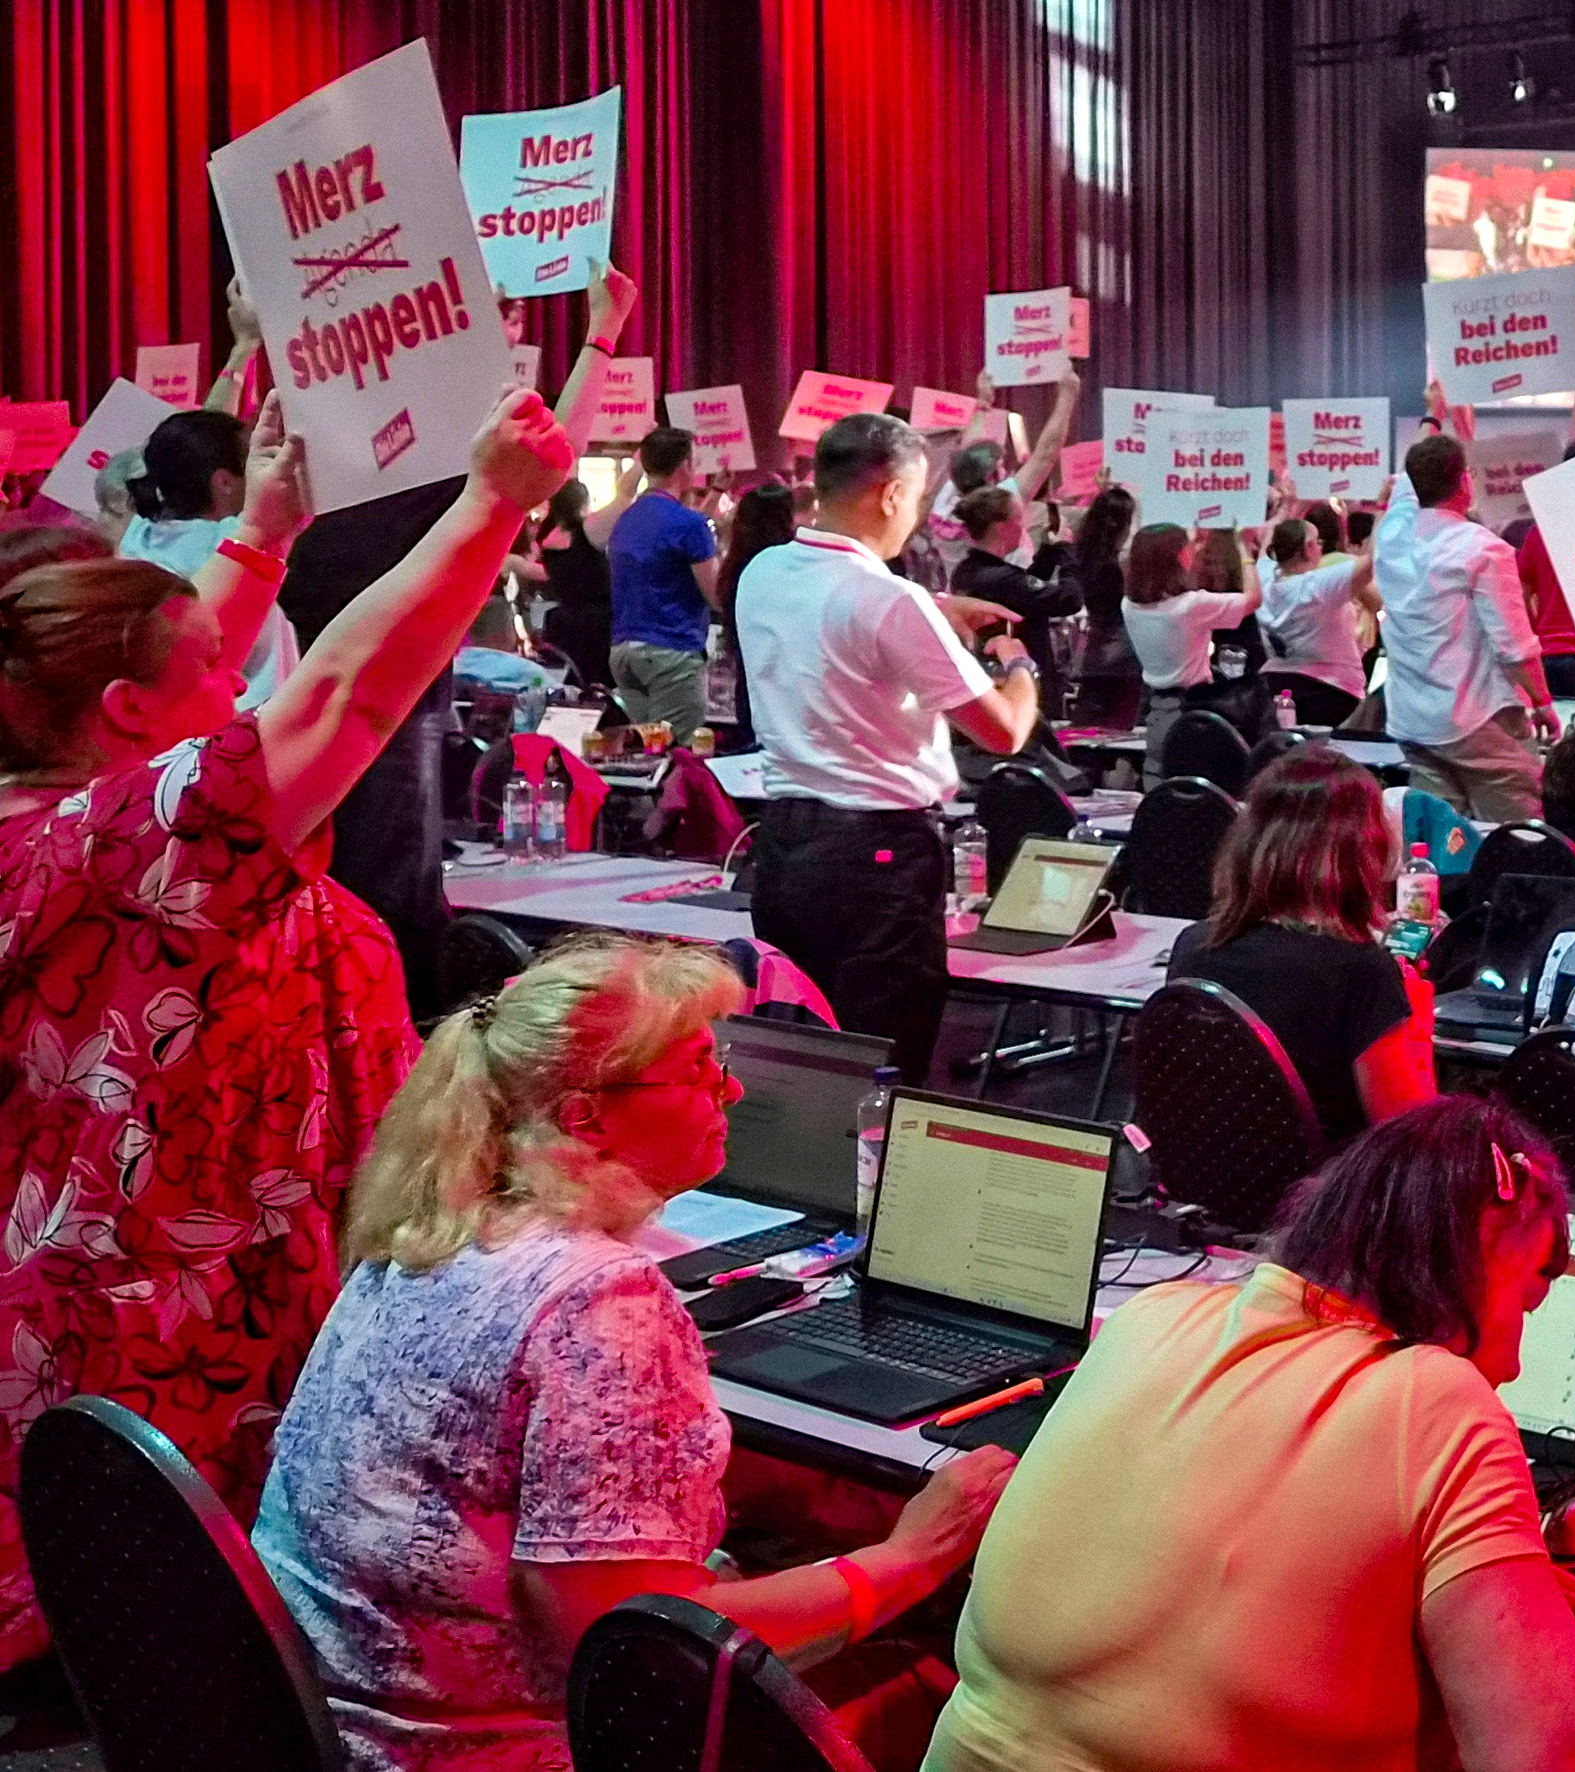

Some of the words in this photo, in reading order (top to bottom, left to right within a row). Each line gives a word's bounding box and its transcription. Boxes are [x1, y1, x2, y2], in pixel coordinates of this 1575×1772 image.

[520, 132, 593, 168] Merz
[276, 144, 385, 241] Merz
[287, 257, 470, 390] stoppen!
[1460, 314, 1496, 340] bei
[1503, 312, 1548, 334] den
[1454, 334, 1559, 367] Reichen!
[1313, 411, 1361, 430] Merz
[1173, 449, 1205, 468] bei
[1210, 449, 1244, 467] den
[1296, 447, 1381, 472] stoppen!
[1165, 472, 1251, 493] Reichen!
